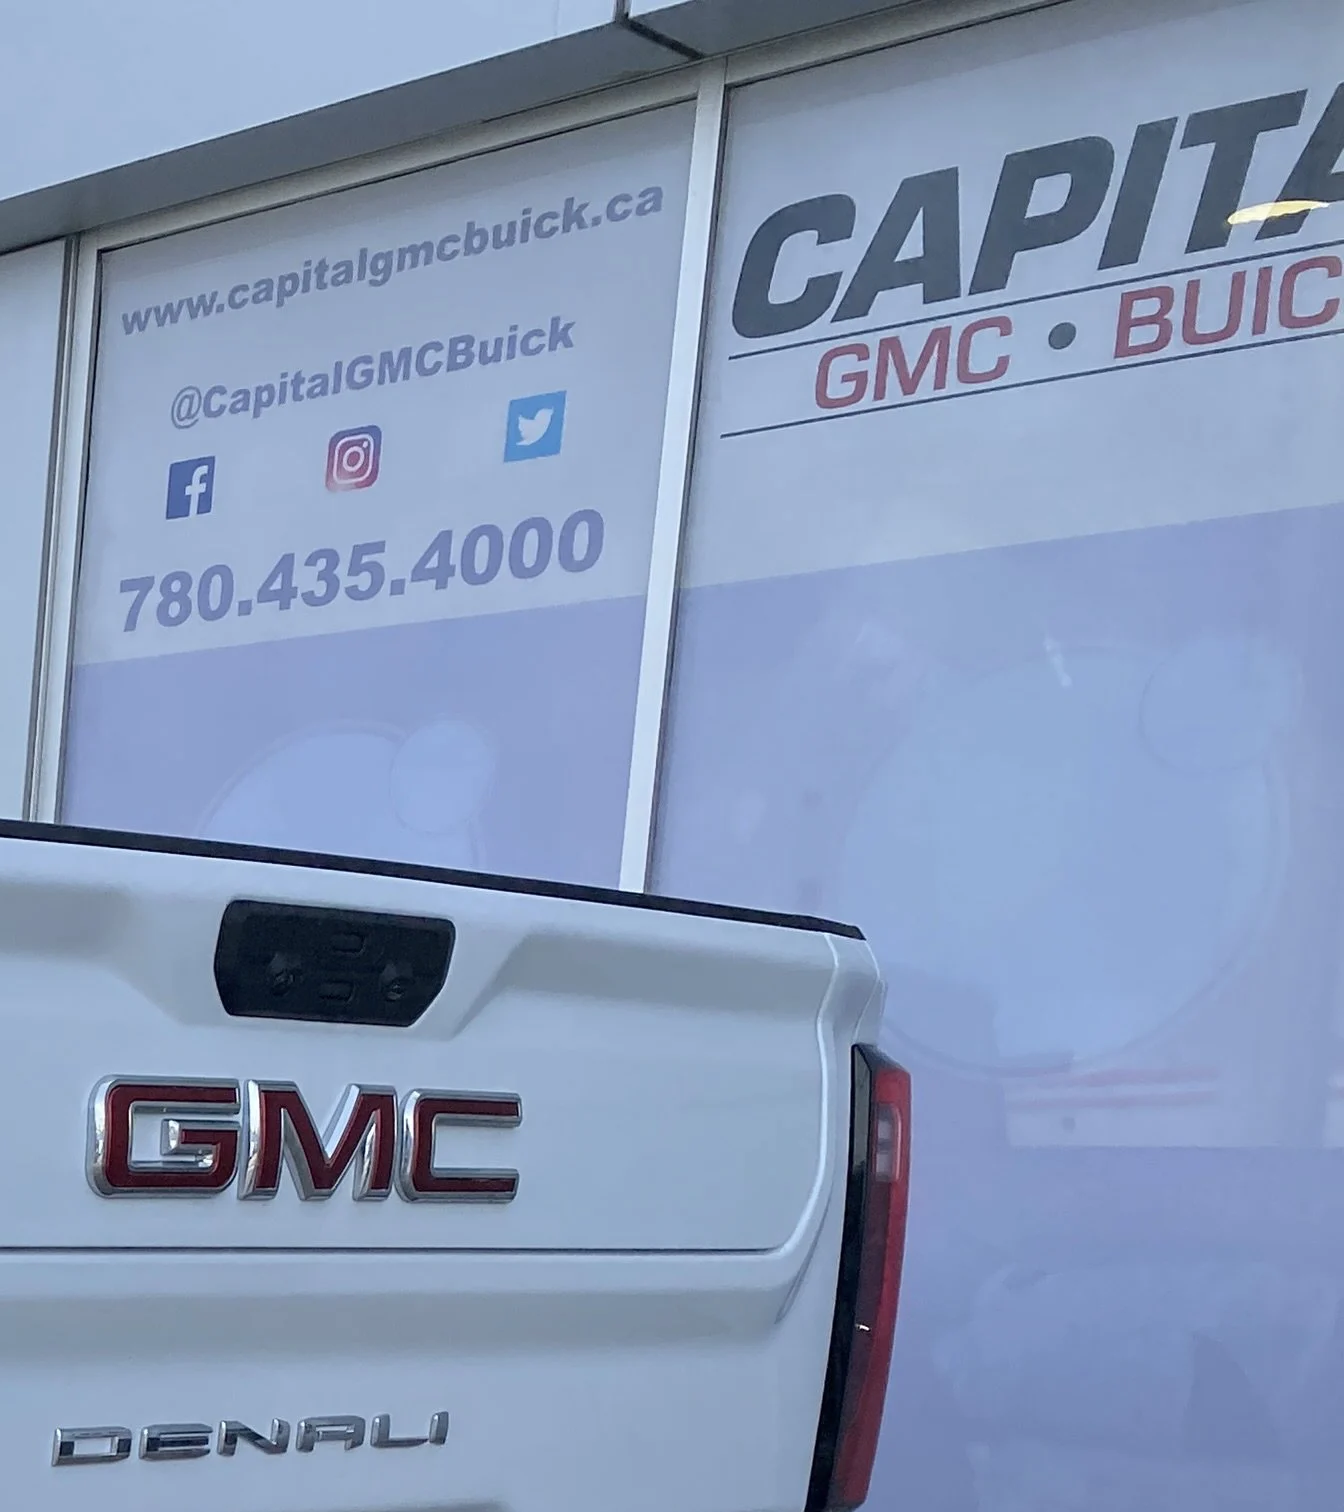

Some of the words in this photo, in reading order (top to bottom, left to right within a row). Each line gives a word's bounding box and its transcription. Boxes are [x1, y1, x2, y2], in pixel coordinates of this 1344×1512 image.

[121, 186, 665, 336] www.capitalgmcbuick.ca
[171, 316, 577, 429] @CapitalGMCBuick
[814, 315, 1012, 409] GMC
[119, 508, 605, 632] 780.435.4000
[86, 1074, 523, 1203] GMC
[52, 1410, 450, 1467] DENALI
